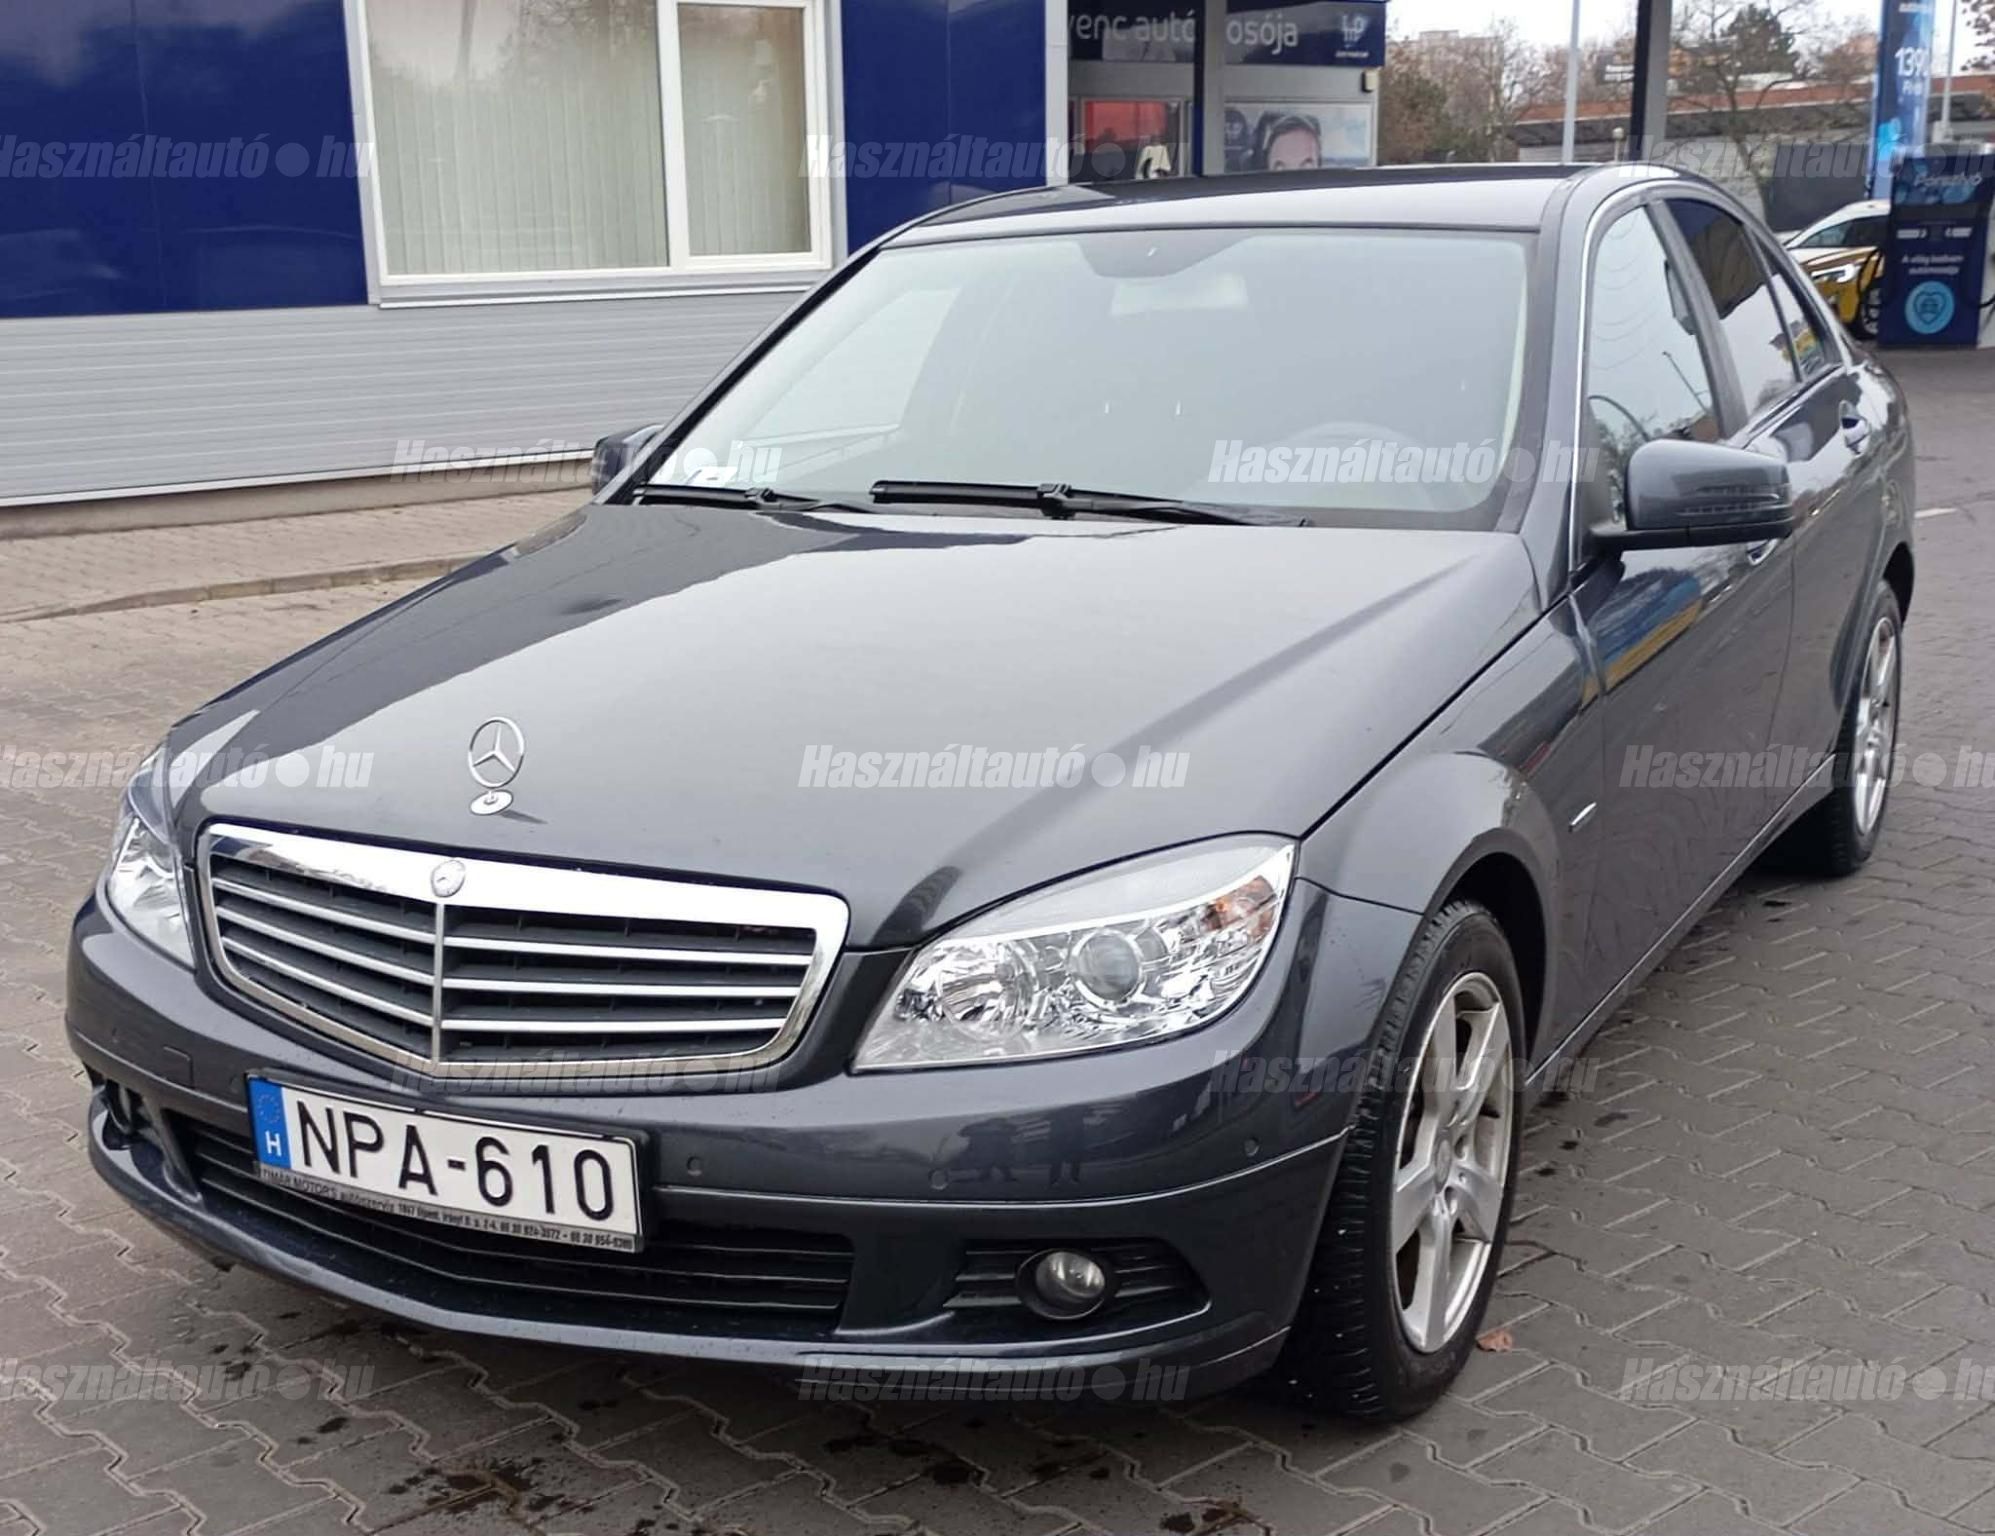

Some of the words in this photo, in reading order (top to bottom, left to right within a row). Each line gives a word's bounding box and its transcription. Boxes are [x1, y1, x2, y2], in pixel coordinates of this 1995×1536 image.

[1226, 12, 1299, 55] osója
[265, 1131, 282, 1157] H
[296, 1100, 613, 1222] NPA-610
